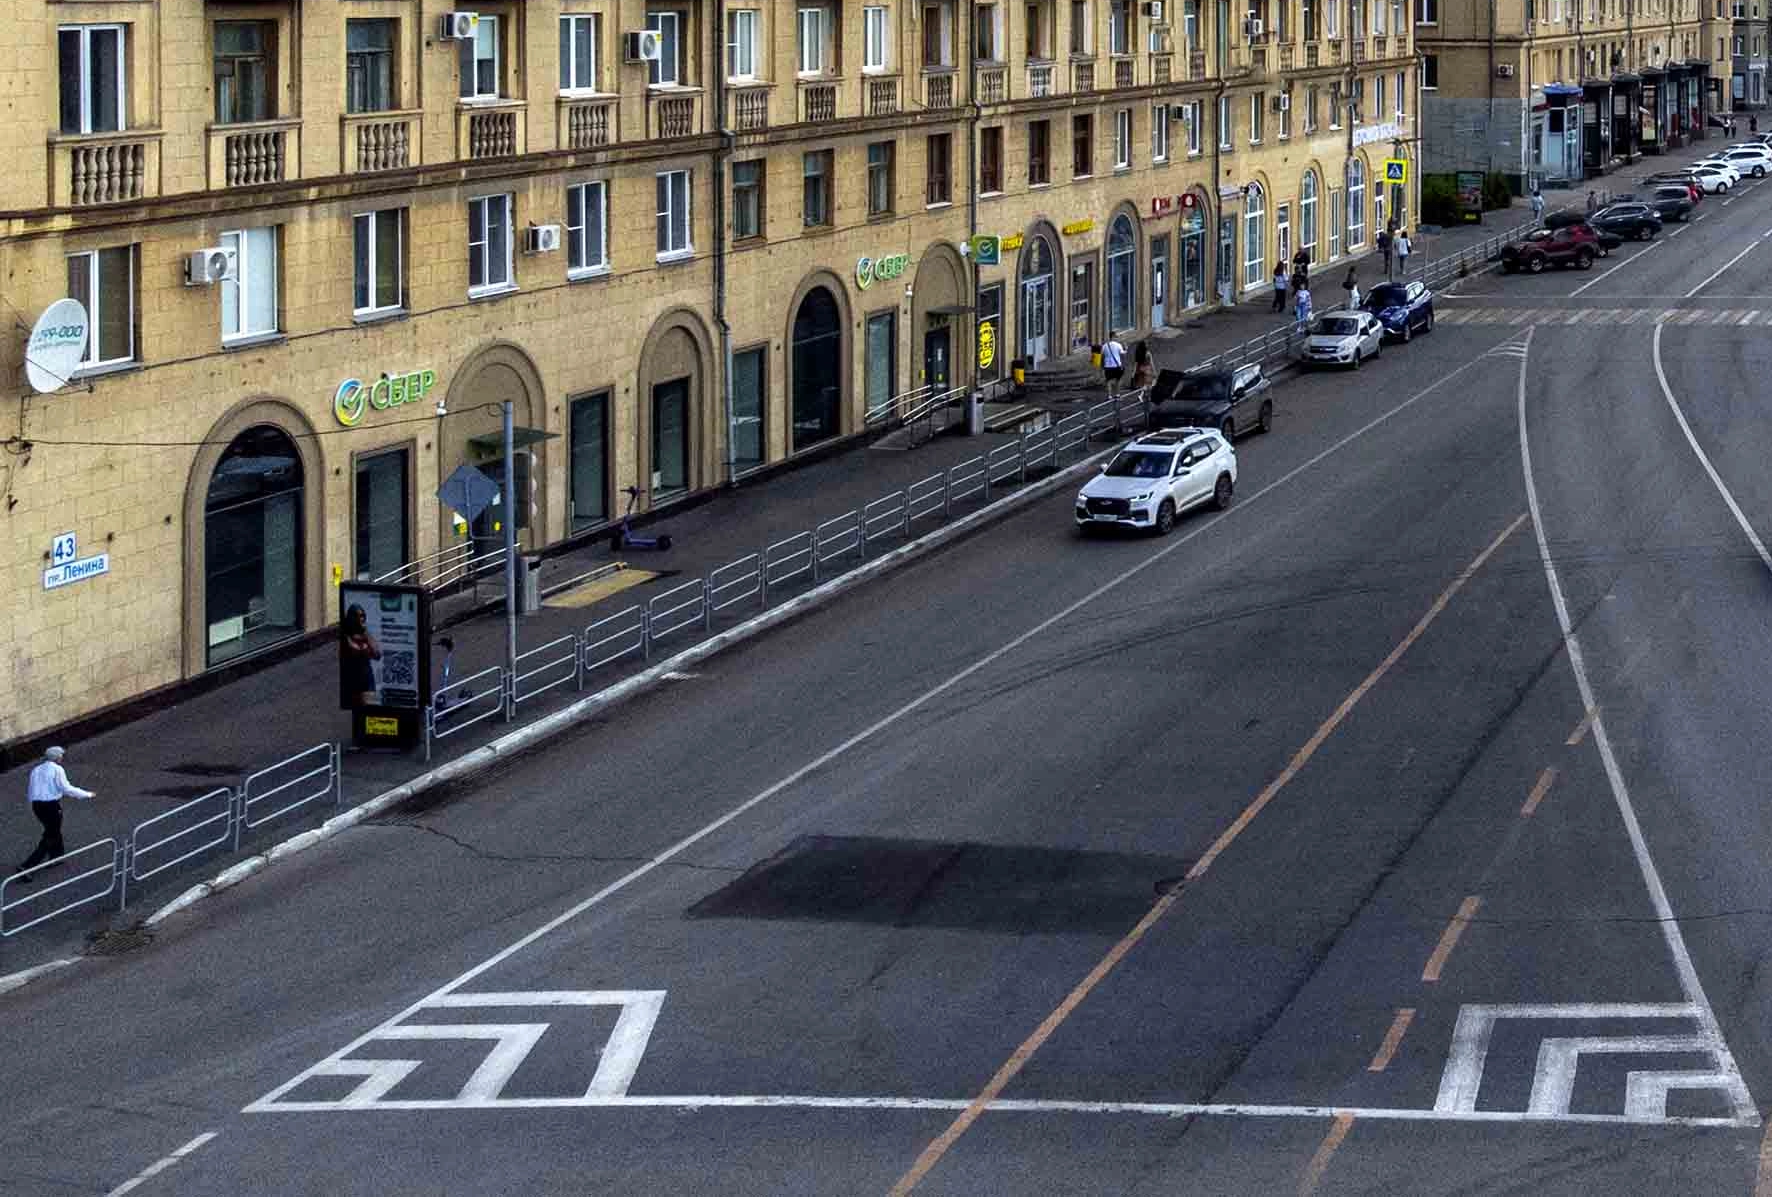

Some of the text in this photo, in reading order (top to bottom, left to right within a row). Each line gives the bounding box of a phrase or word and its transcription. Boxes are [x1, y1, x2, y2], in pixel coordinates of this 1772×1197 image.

[371, 369, 435, 410] СБЕР
[55, 537, 75, 560] 43
[63, 557, 105, 581] Ленина
